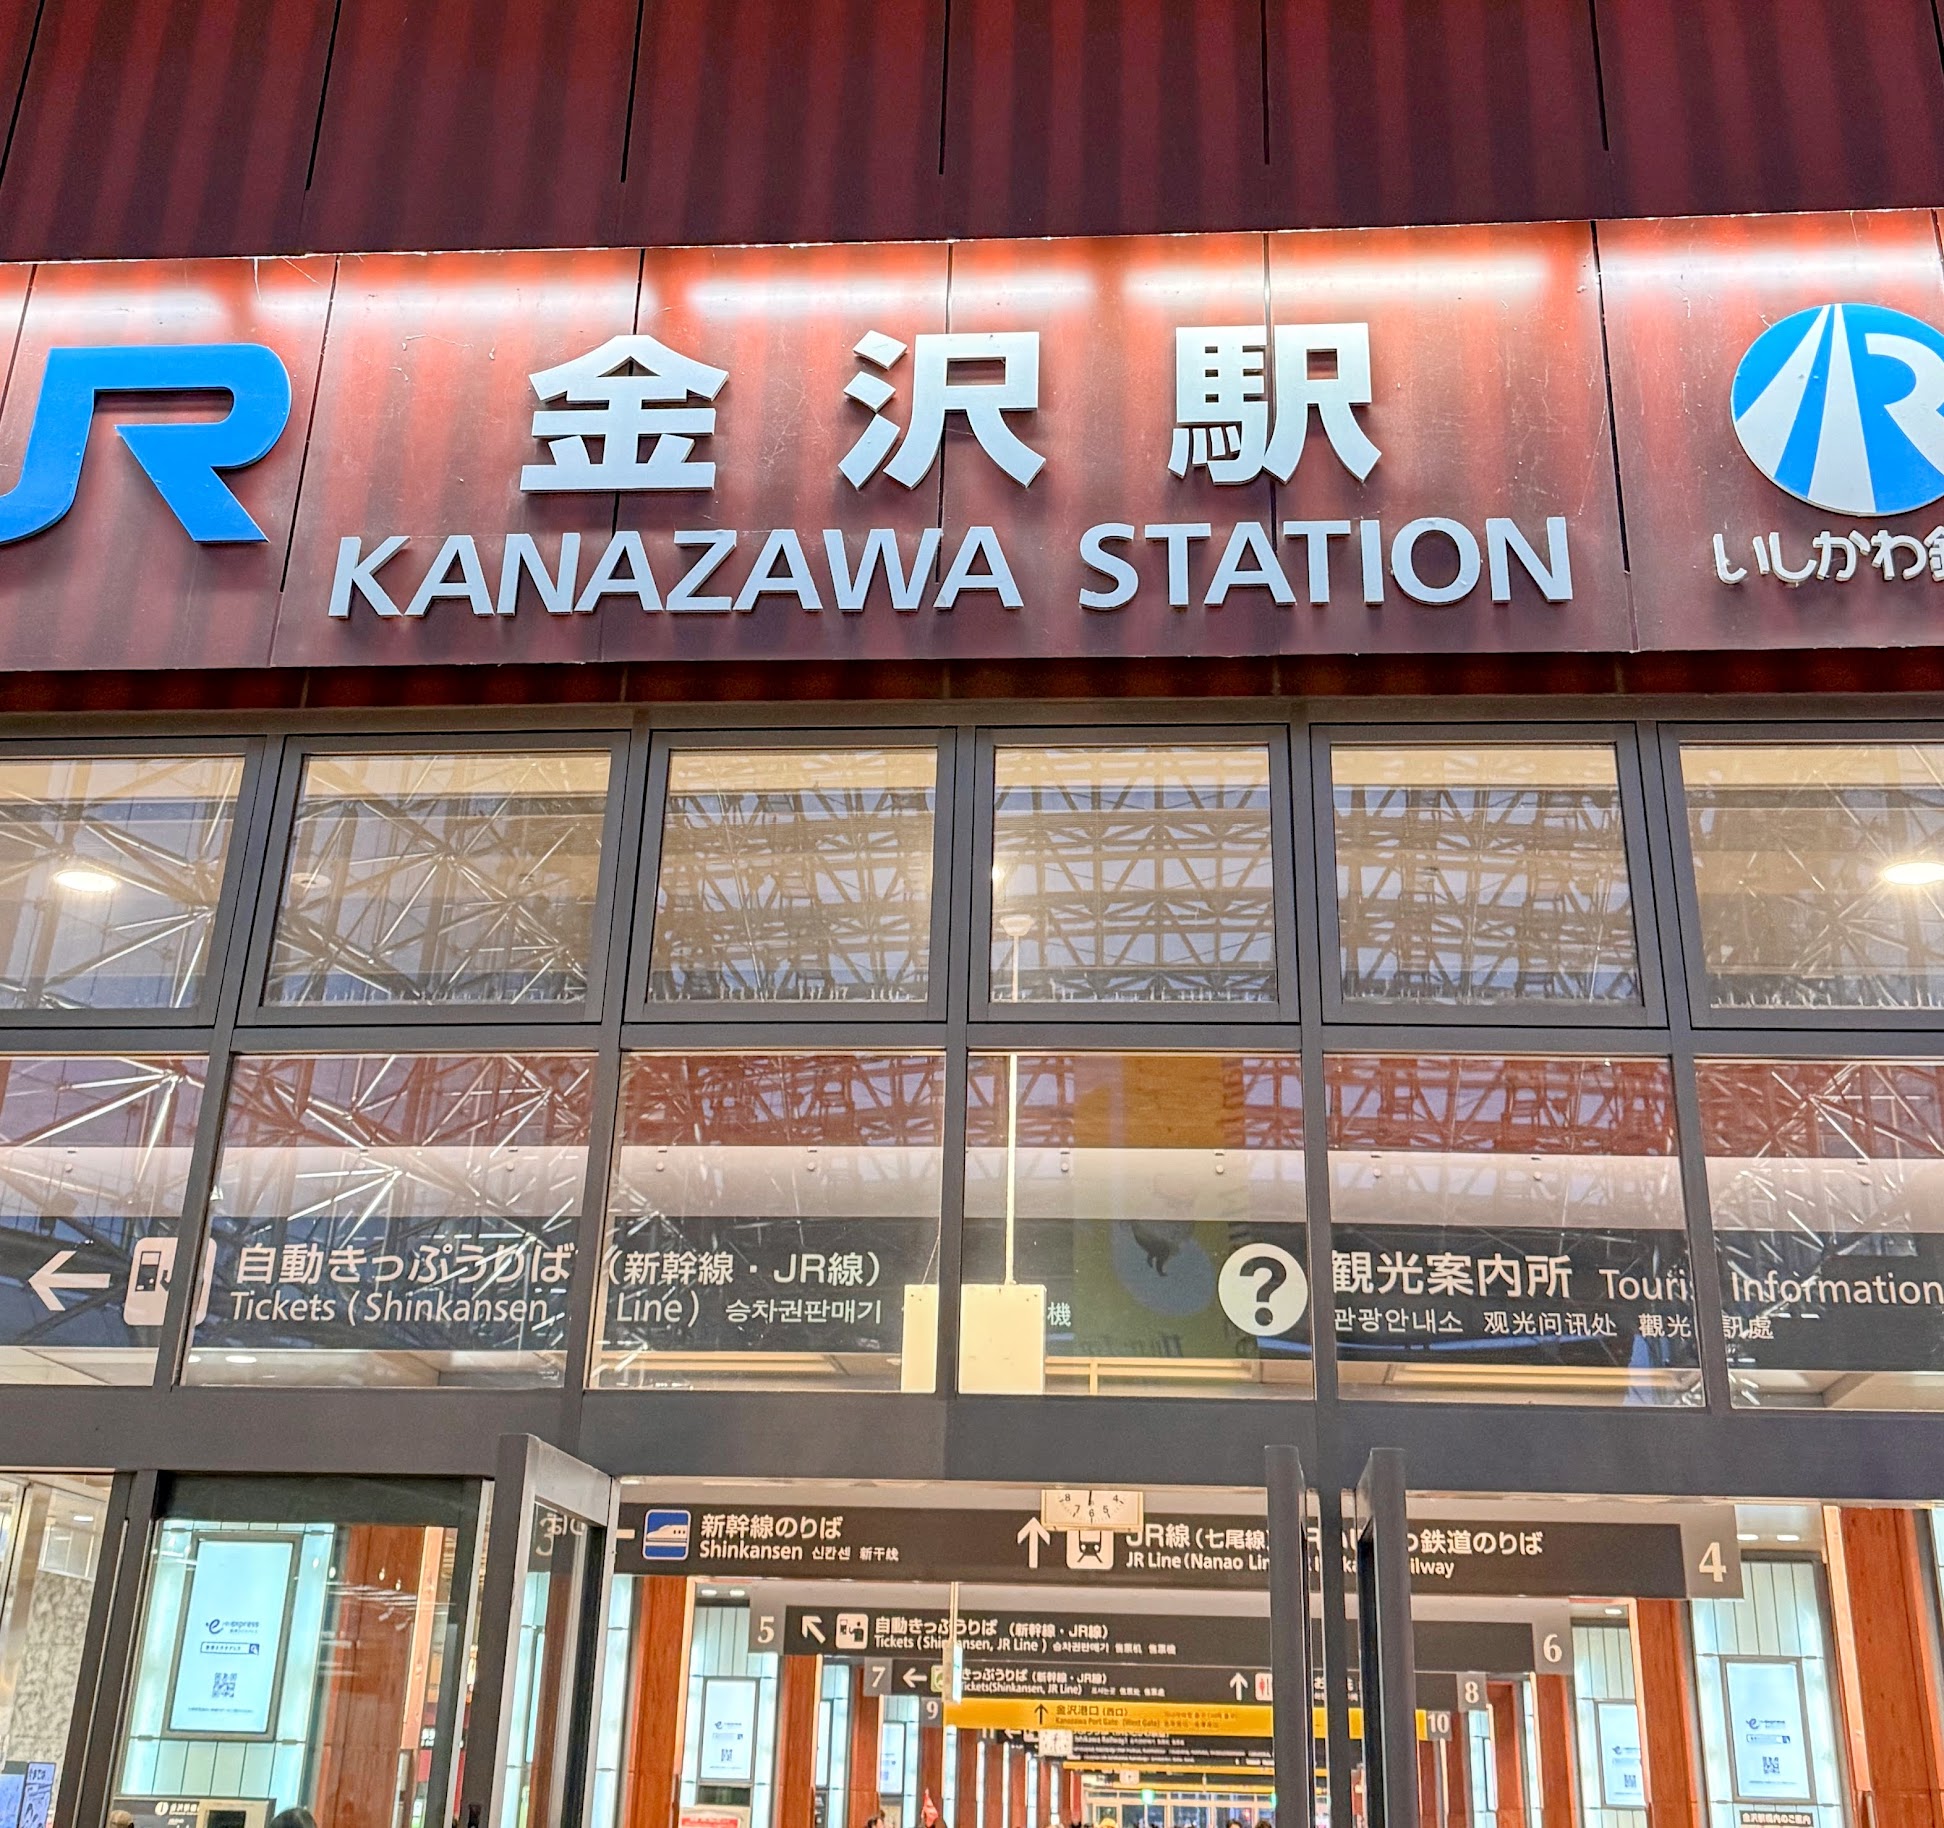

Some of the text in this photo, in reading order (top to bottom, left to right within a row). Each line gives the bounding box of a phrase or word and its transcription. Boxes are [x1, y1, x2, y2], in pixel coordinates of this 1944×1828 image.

[520, 322, 1381, 491] 金沢駅
[0, 343, 291, 544] JR
[328, 516, 1574, 617] KANAZAWA STATION
[237, 1243, 576, 1285] 自動きっぷうりば
[1331, 1250, 1573, 1298] 観光案内所
[1731, 1270, 1944, 1304] Information
[230, 1290, 337, 1321] Tickets
[725, 1298, 881, 1324] 승차권판매기
[1334, 1307, 1463, 1334] 관광안내소
[1483, 1310, 1774, 1340] 观光问讯处 觀光訊處
[701, 1513, 844, 1540] 新幹線のりば
[700, 1540, 802, 1560] Shinkansen
[1126, 1551, 1144, 1568] JR
[1699, 1541, 1728, 1583] 4
[757, 1615, 775, 1644] 5
[874, 1634, 914, 1649] Tickets
[997, 1639, 1010, 1650] JR
[1542, 1633, 1563, 1663] 6
[871, 1666, 886, 1688] 7
[1464, 1681, 1479, 1704] 8
[926, 1700, 939, 1720] 9
[1427, 1712, 1450, 1733] 10
